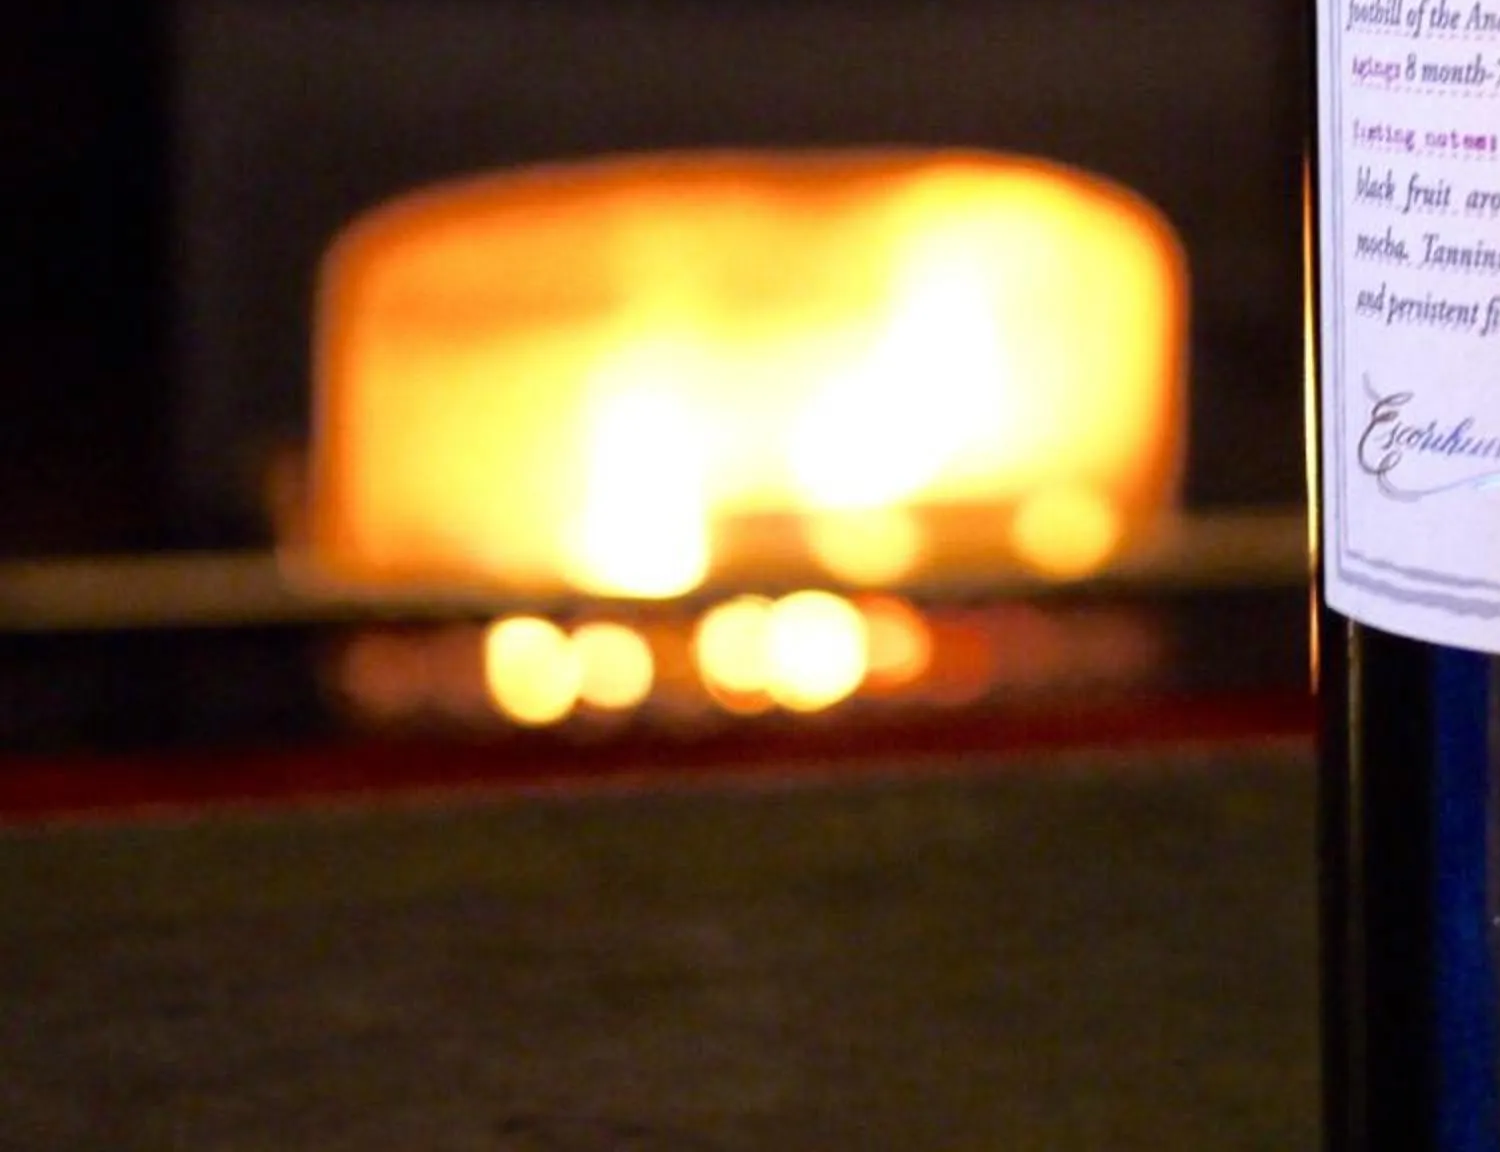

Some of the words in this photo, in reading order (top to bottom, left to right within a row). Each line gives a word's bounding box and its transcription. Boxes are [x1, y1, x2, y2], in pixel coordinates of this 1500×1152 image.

[1404, 51, 1418, 82] 8
[1356, 164, 1396, 201] black
[1402, 171, 1452, 215] fruit
[1356, 280, 1388, 314] and
[1385, 290, 1481, 328] persistent
